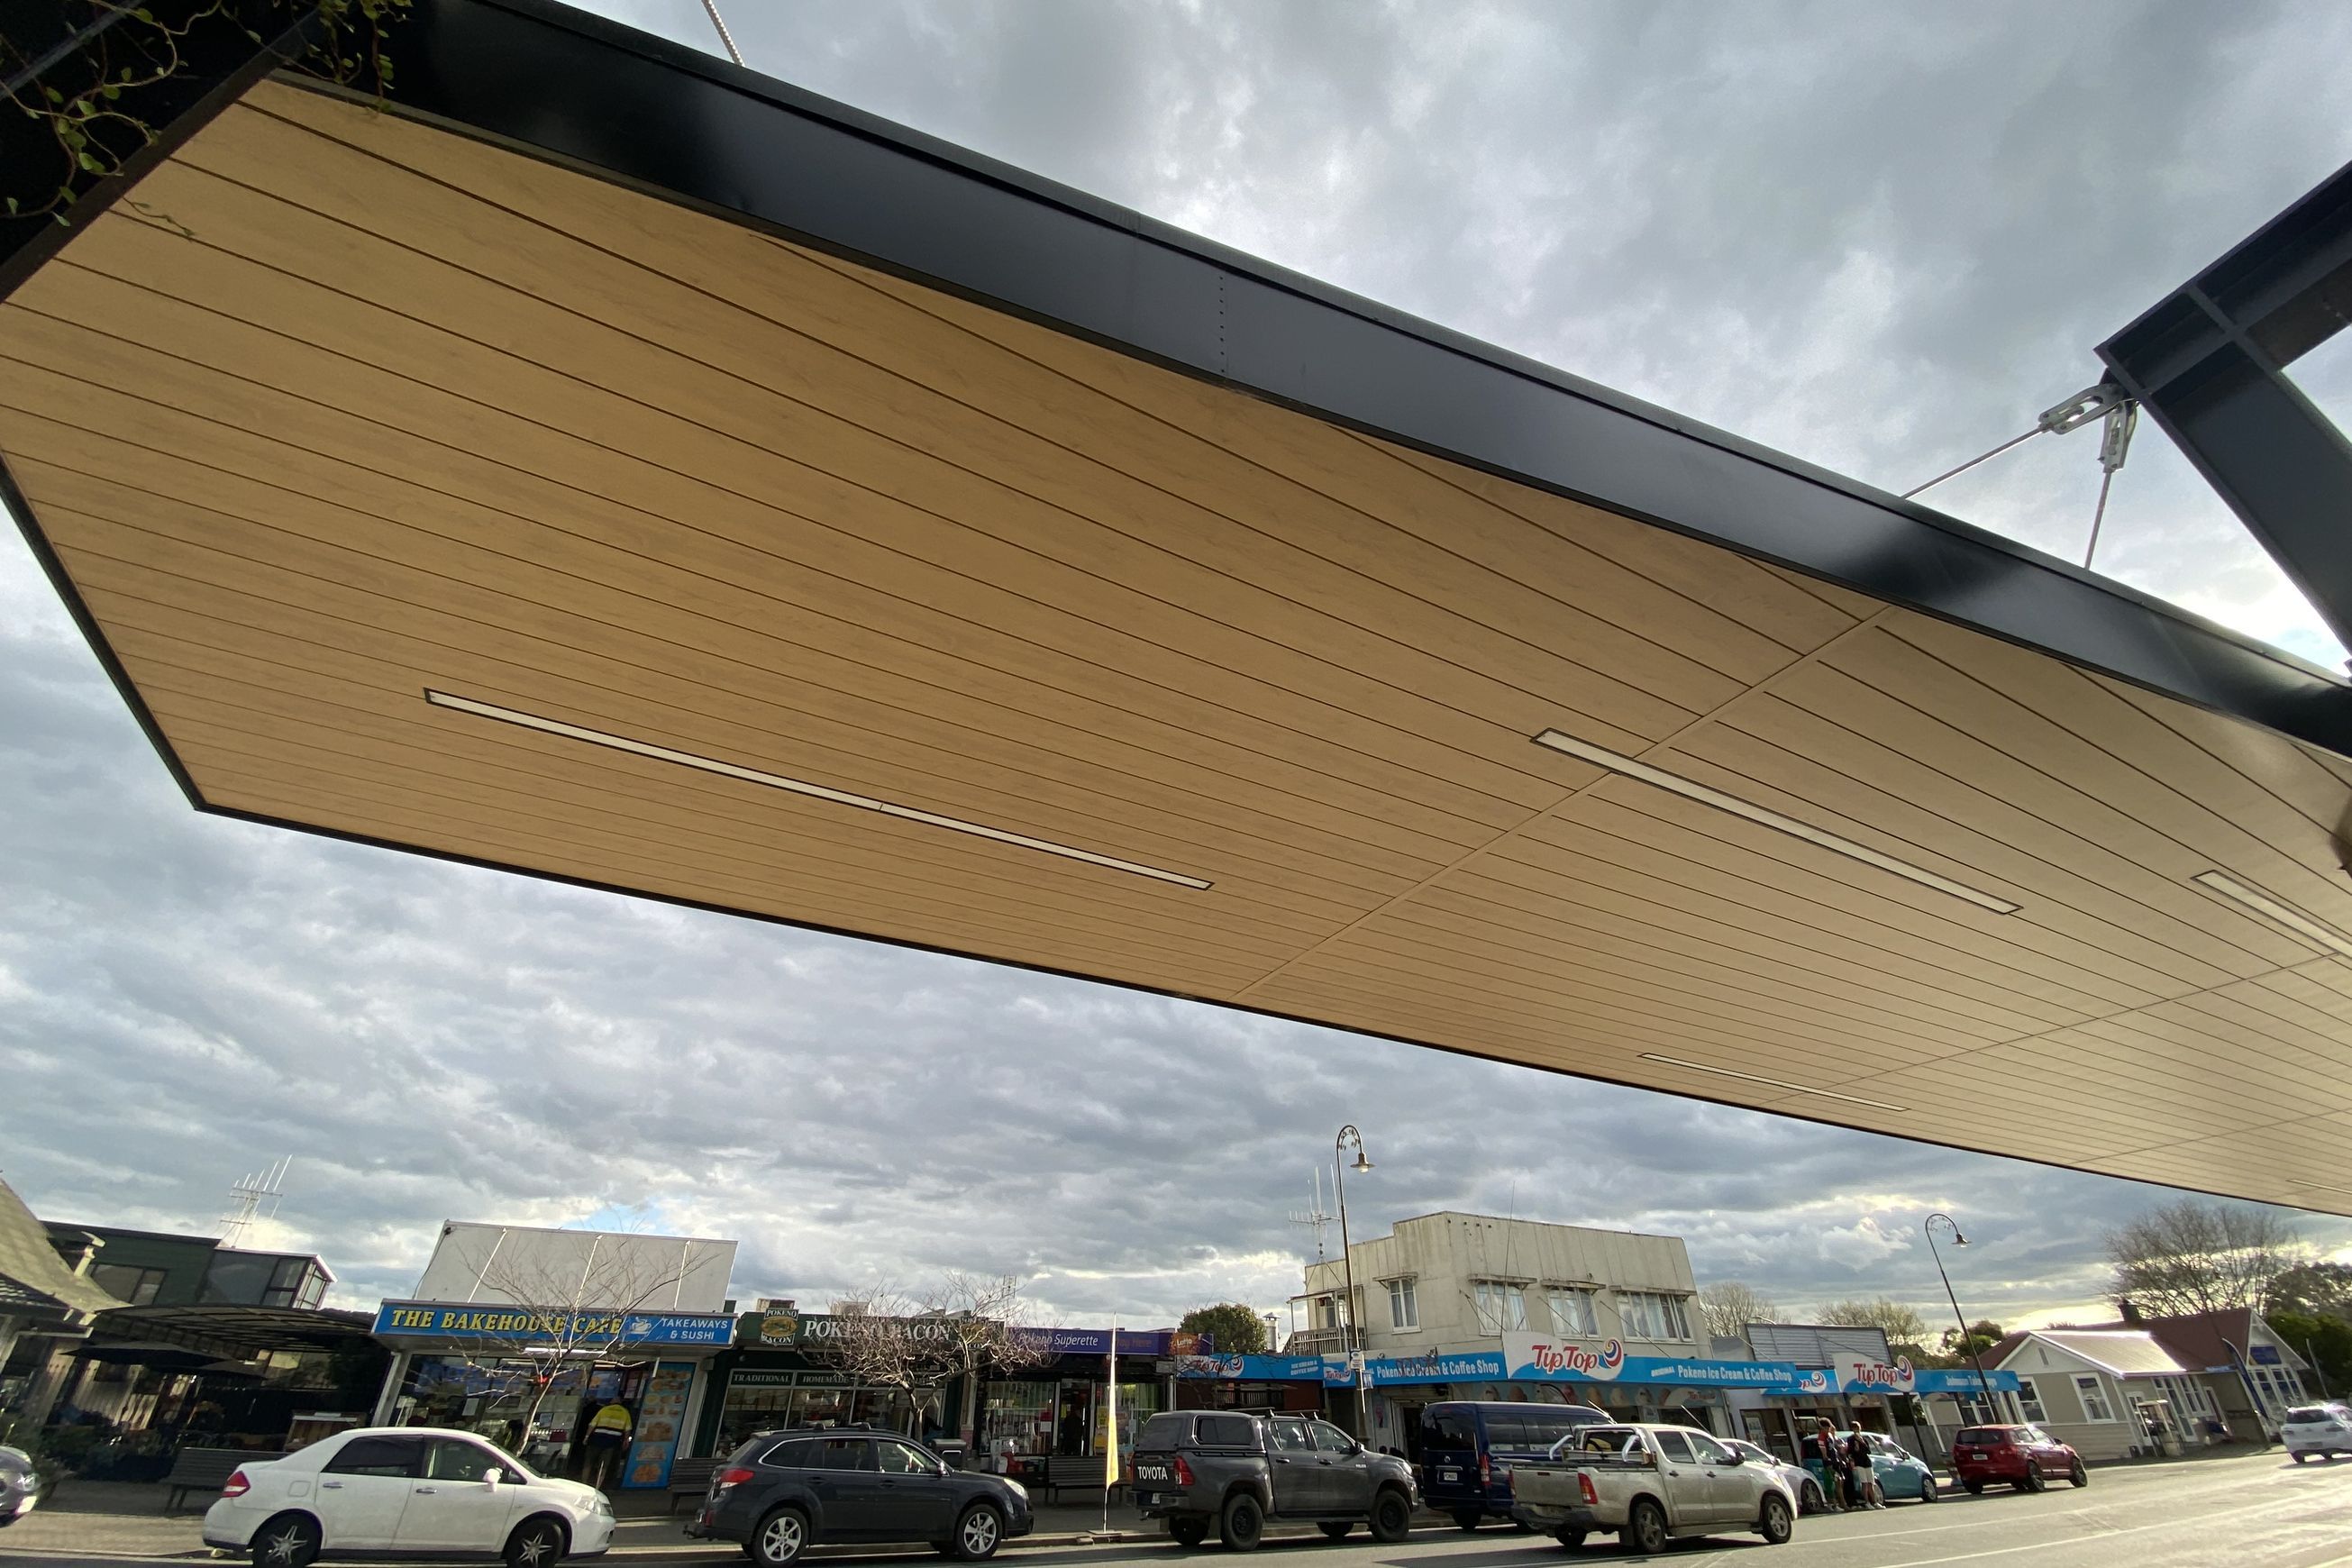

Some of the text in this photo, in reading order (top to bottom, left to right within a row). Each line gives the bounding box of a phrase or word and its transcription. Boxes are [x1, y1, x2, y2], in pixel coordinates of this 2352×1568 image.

[766, 1309, 798, 1317] POKENO
[390, 1309, 435, 1328] THE
[440, 1312, 565, 1334] BAKEHOUSE
[662, 1318, 728, 1329] TAKEAWAYS
[670, 1330, 716, 1340] & SUSHI
[890, 1321, 953, 1342] ACON
[1053, 1334, 1099, 1347] Superette
[1176, 1337, 1193, 1345] Lotto
[1532, 1345, 1598, 1373] Tip Top
[1442, 1363, 1449, 1375] &
[1449, 1362, 1476, 1375] Coffee
[1477, 1359, 1500, 1376] Shop
[1677, 1364, 1707, 1379] Pokeno
[1708, 1366, 1720, 1380] Ice
[1720, 1367, 1744, 1381] Cream
[1744, 1368, 1751, 1380] &
[1751, 1368, 1773, 1381] Coffee
[1774, 1368, 1792, 1383] Shop
[1853, 1363, 1898, 1388] Tip Top
[734, 1374, 849, 1383] TRADITIONAL HOMEMADE
[1137, 1465, 1169, 1481] TOYOTA
